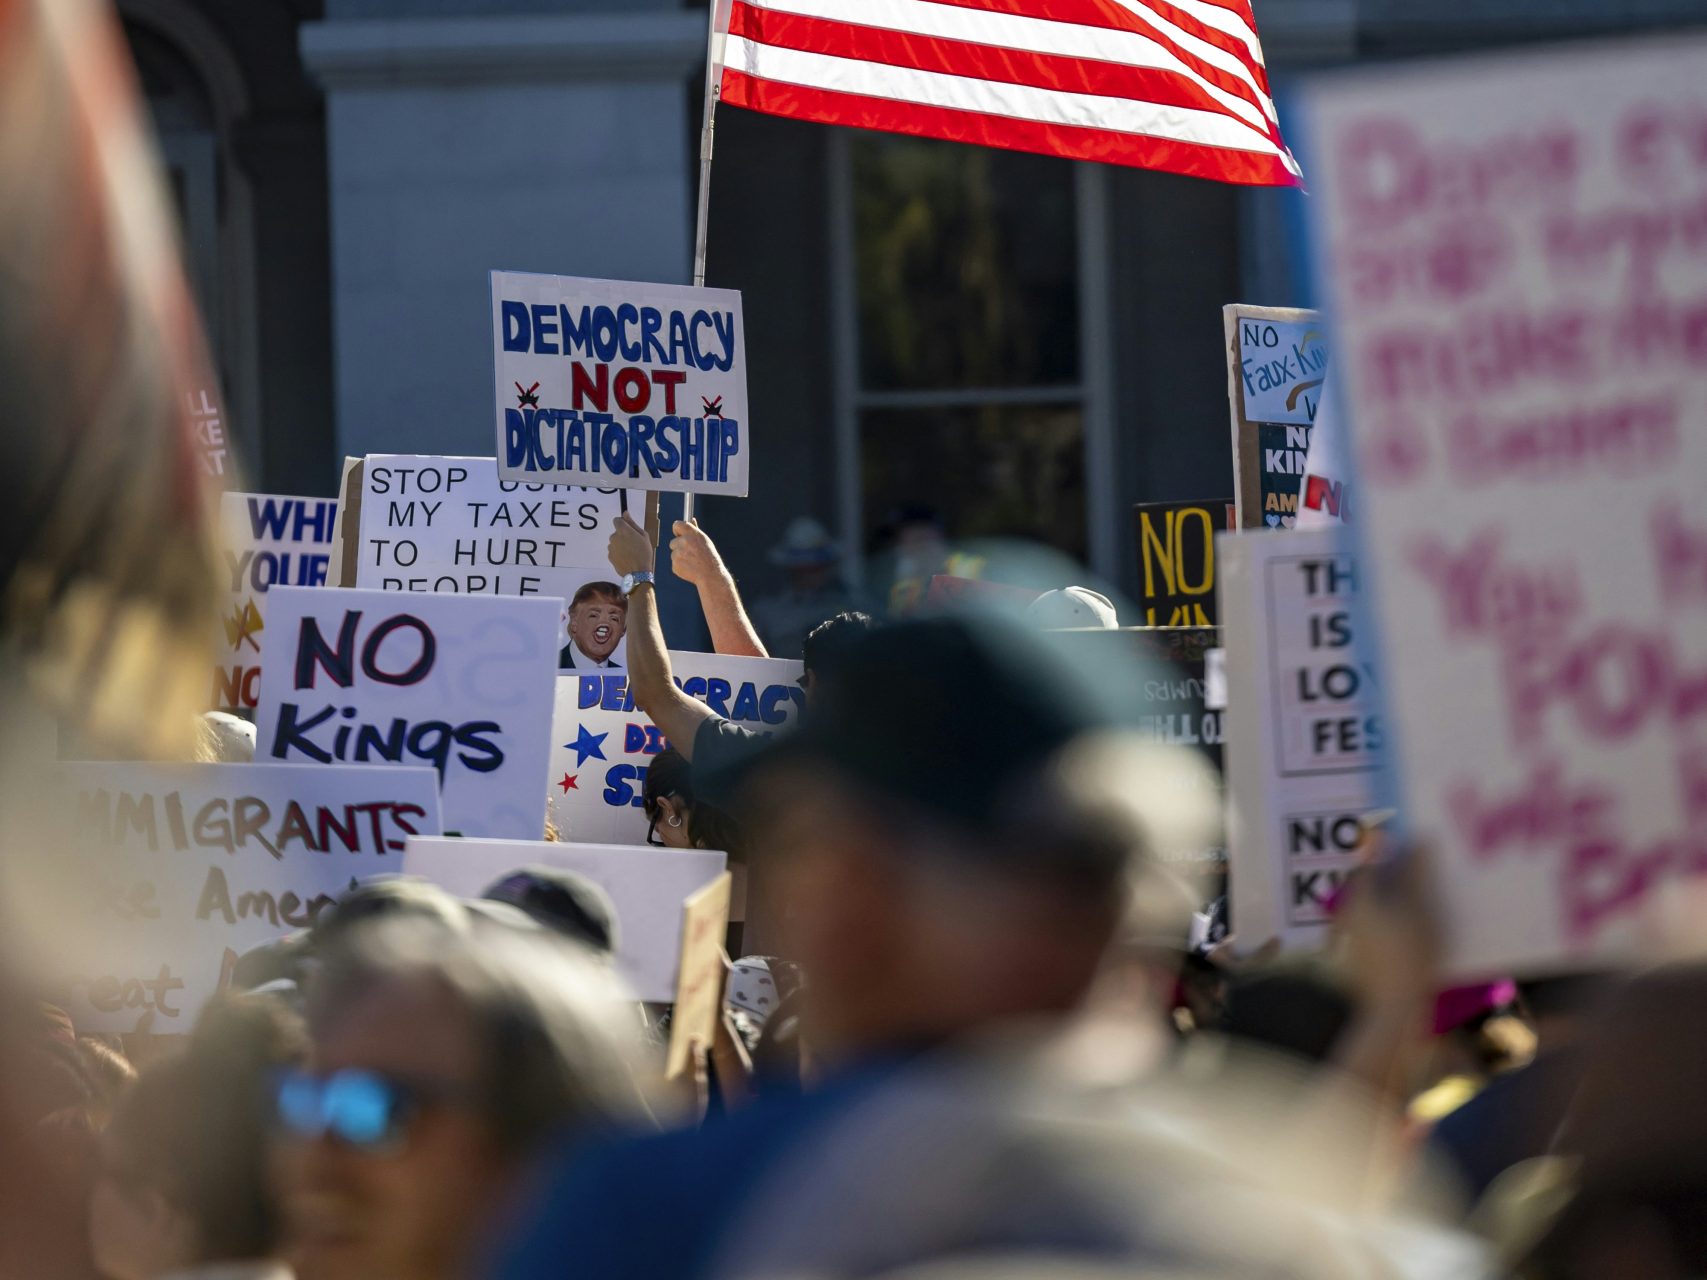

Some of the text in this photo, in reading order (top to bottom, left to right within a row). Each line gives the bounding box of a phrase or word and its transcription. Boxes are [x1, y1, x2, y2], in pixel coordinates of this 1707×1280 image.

[502, 300, 735, 372] DEMOCRACY
[1243, 323, 1279, 348] NO
[571, 361, 687, 414] NOT
[505, 408, 739, 483] DICTATORSHIP
[1285, 426, 1313, 449] N
[370, 467, 468, 495] STOP
[388, 500, 600, 531] MY TAXES
[369, 538, 566, 568] TO HURT
[1140, 507, 1214, 598] NO
[294, 609, 437, 691] NO
[1308, 615, 1353, 648] IS
[624, 723, 670, 755] DI
[76, 787, 427, 860] MMIGRANTS
[1289, 815, 1362, 853] NO
[195, 864, 345, 929] Amer
